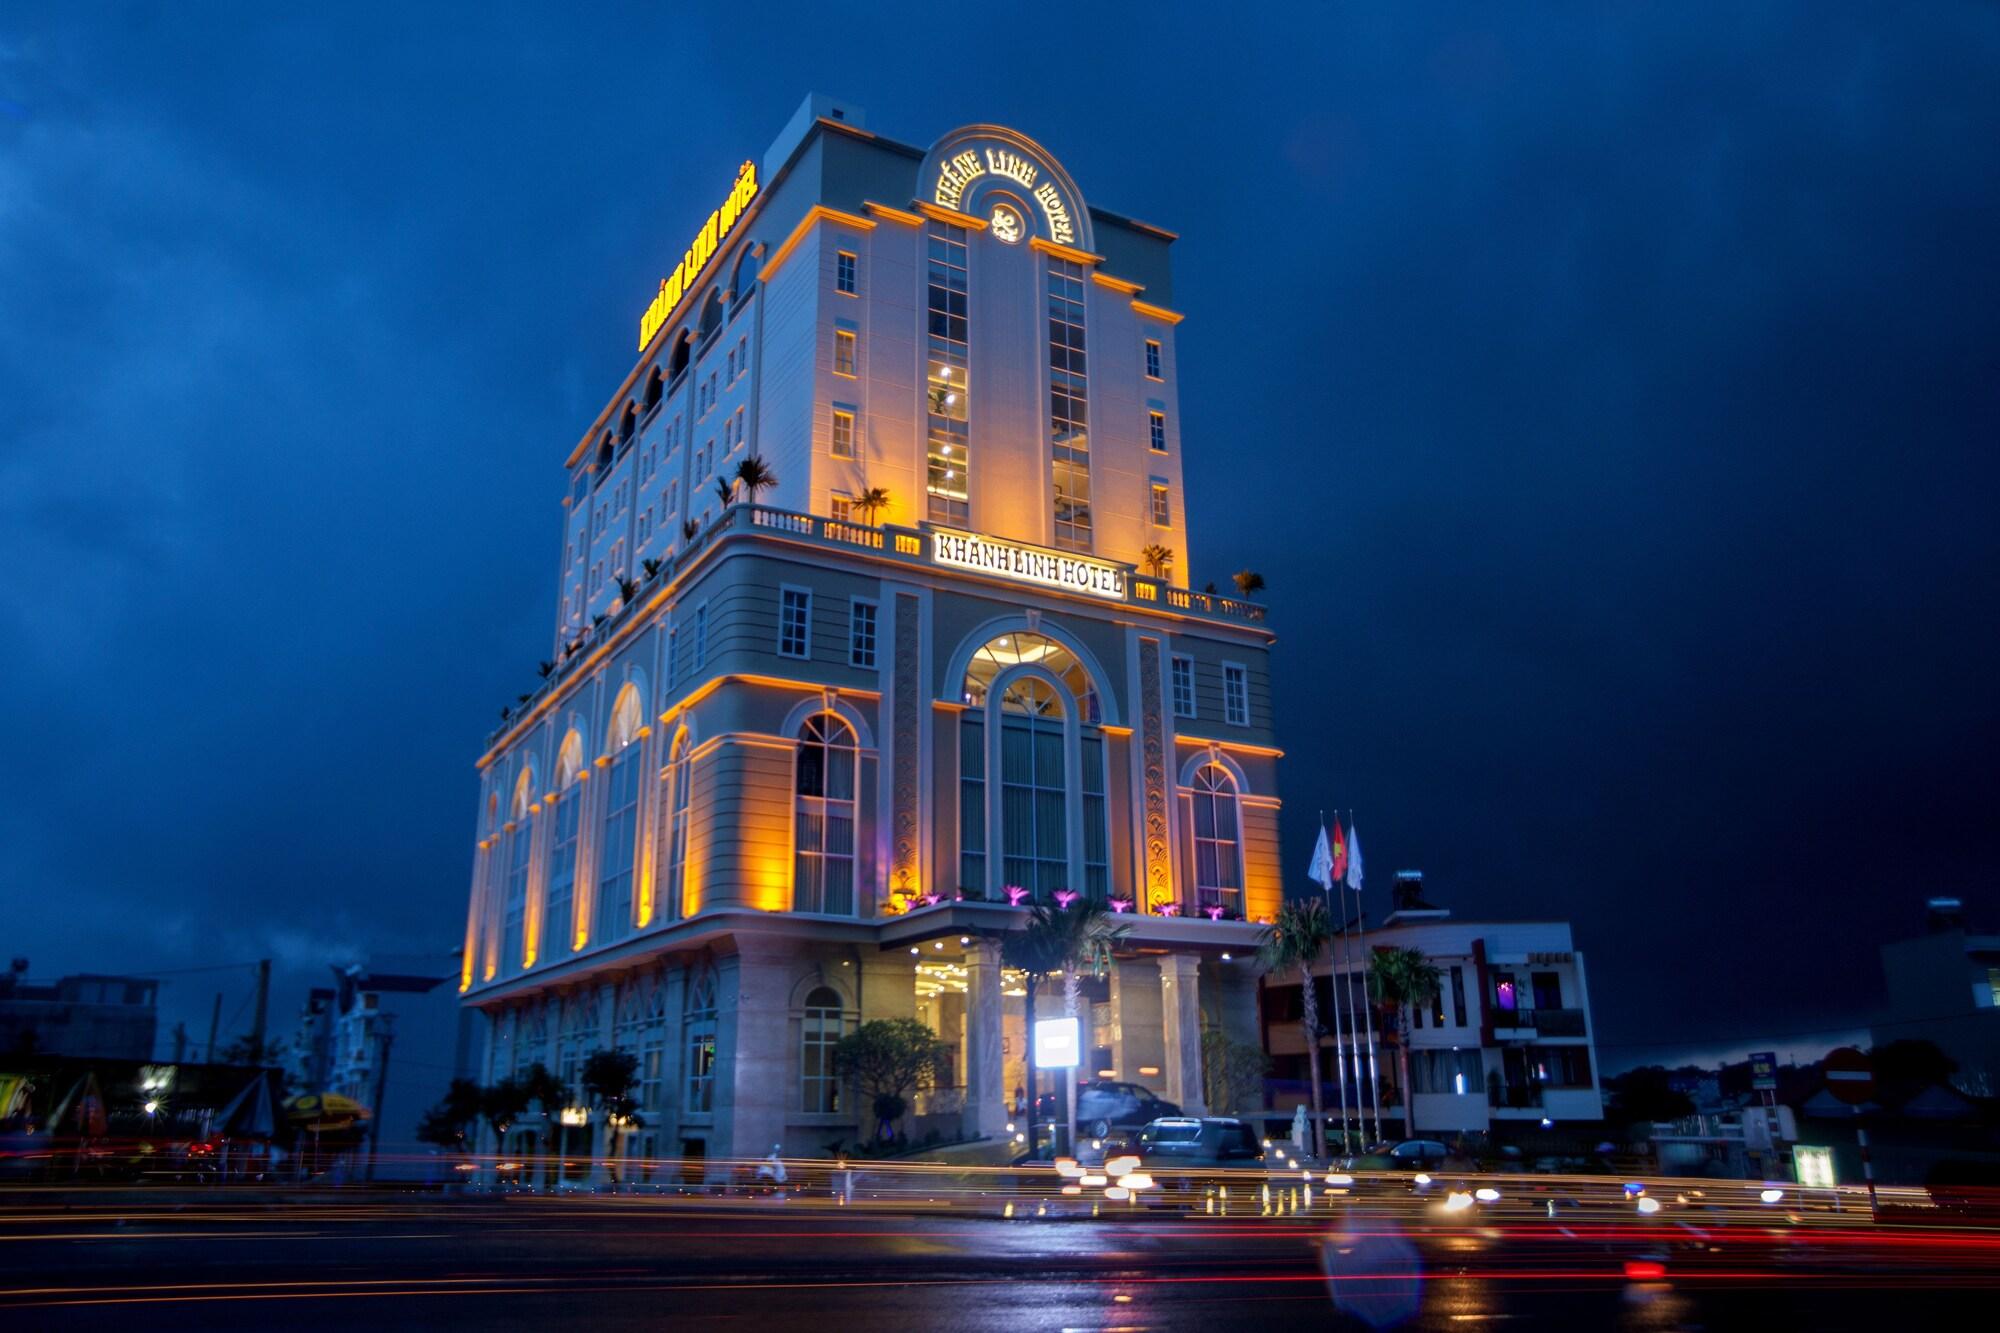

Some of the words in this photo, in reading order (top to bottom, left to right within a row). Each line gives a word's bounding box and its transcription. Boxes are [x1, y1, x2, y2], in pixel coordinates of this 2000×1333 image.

[986, 148, 1037, 189] LINH
[1034, 182, 1075, 244] HOTEL
[939, 534, 1009, 570] KHÁNH
[1013, 549, 1060, 581] LINH
[1063, 559, 1123, 594] HOTEL
